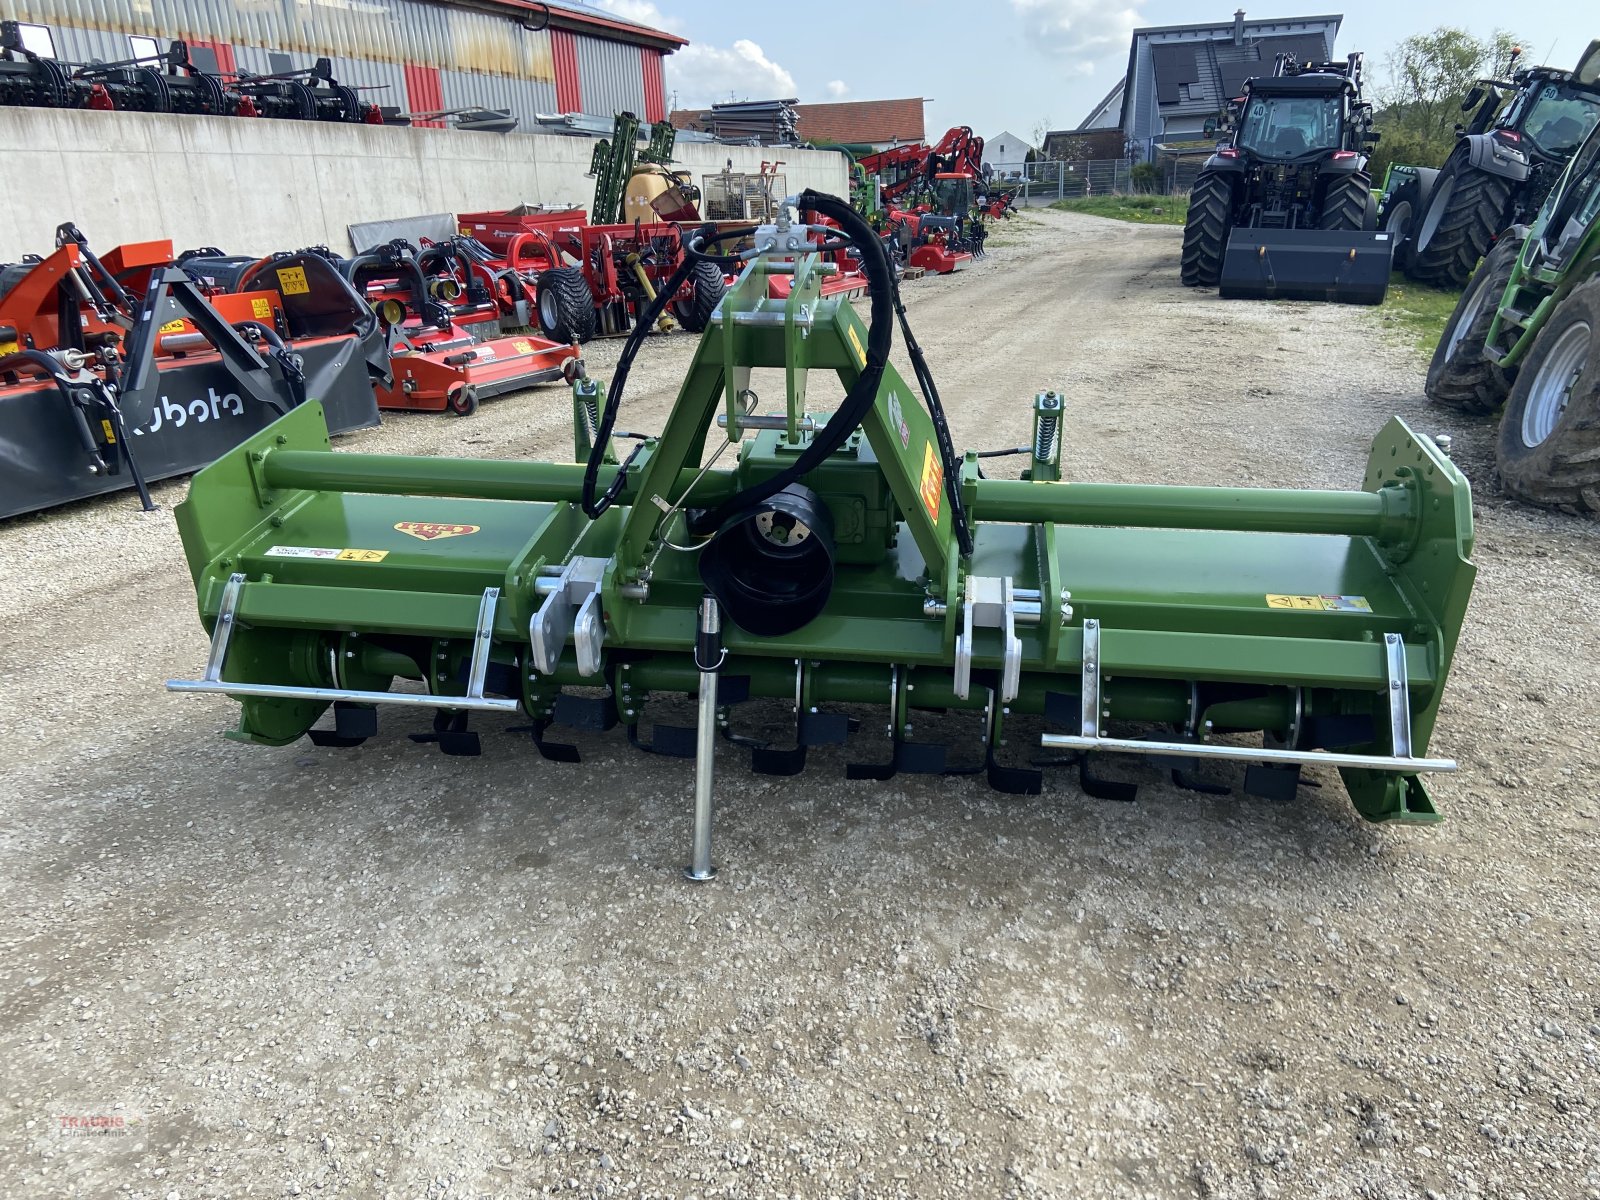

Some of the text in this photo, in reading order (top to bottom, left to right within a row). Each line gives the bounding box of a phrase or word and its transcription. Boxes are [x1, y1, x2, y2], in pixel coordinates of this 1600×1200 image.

[1544, 88, 1556, 99] 50
[1253, 106, 1264, 116] 40
[133, 388, 244, 435] ubota
